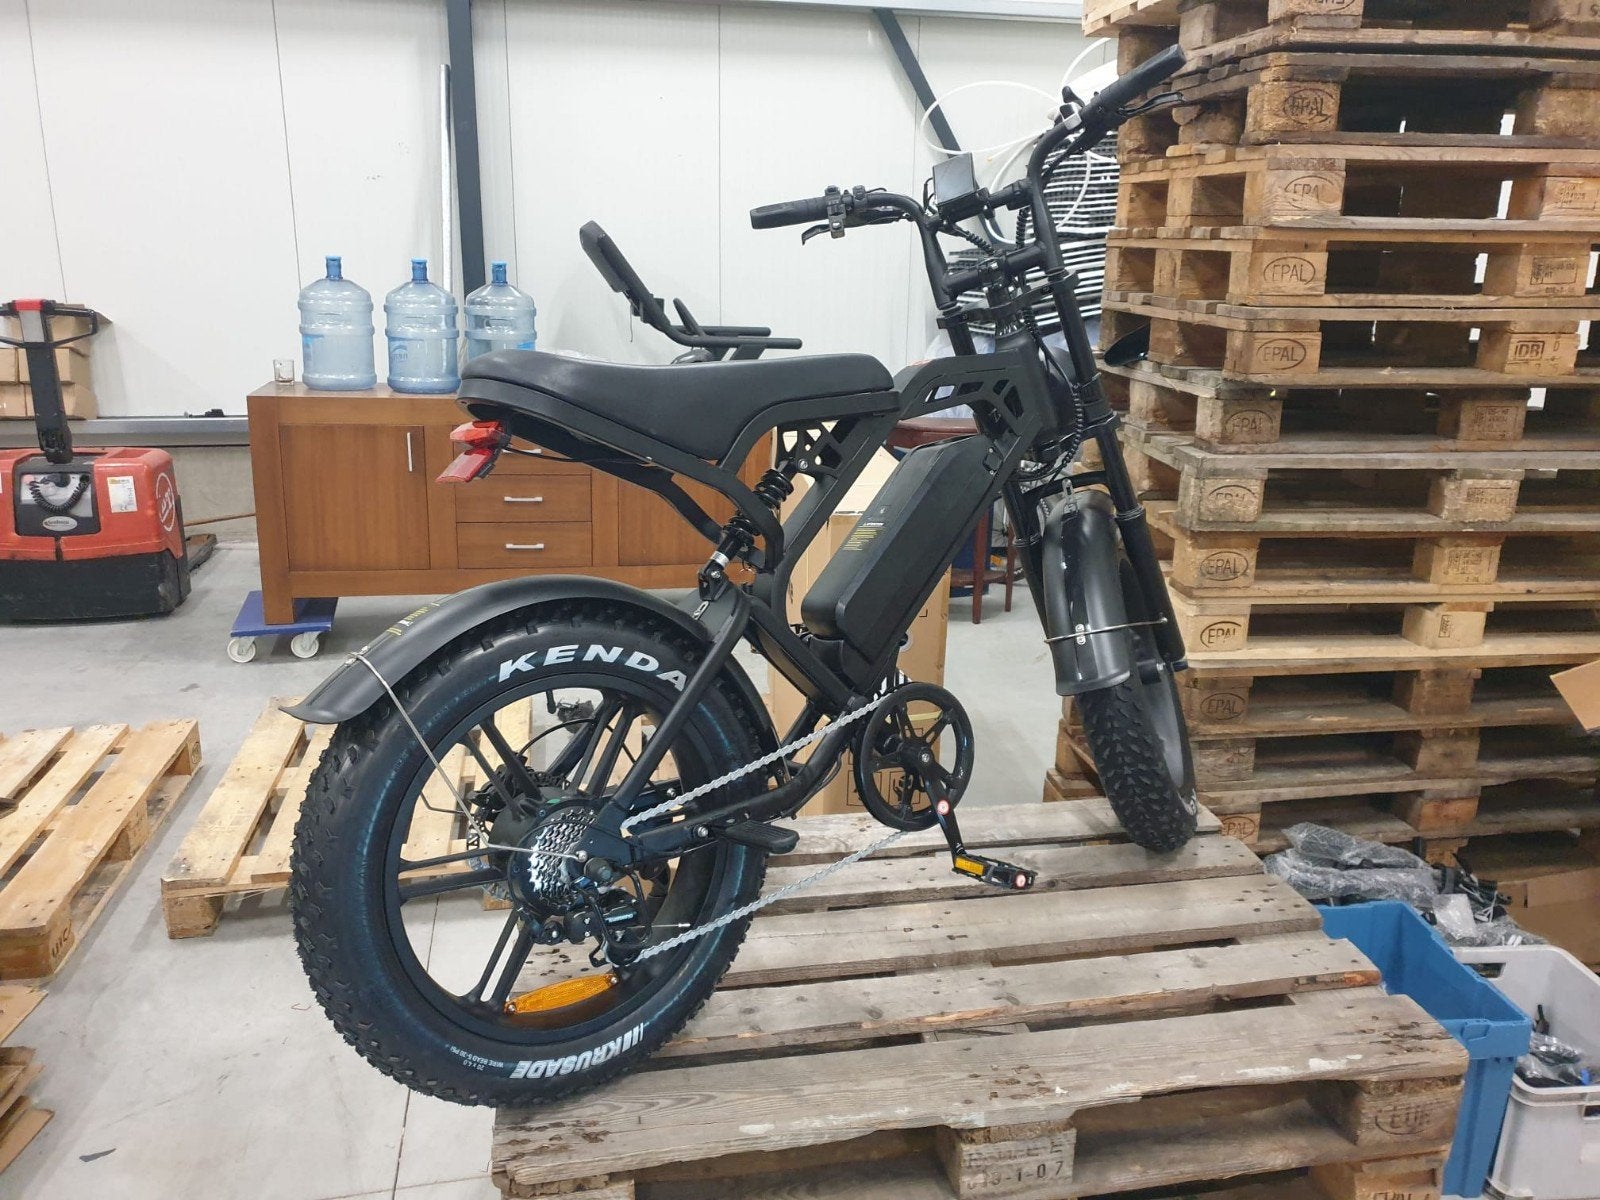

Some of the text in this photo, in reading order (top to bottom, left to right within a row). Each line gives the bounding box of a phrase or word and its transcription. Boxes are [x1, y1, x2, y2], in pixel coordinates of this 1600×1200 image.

[1272, 263, 1309, 283] EPAL
[1263, 345, 1300, 362] EPAL
[1206, 558, 1240, 576] EPAL
[499, 644, 687, 692] KENDA
[1206, 698, 1241, 716] EPAL
[509, 1036, 622, 1079] KRUSADE
